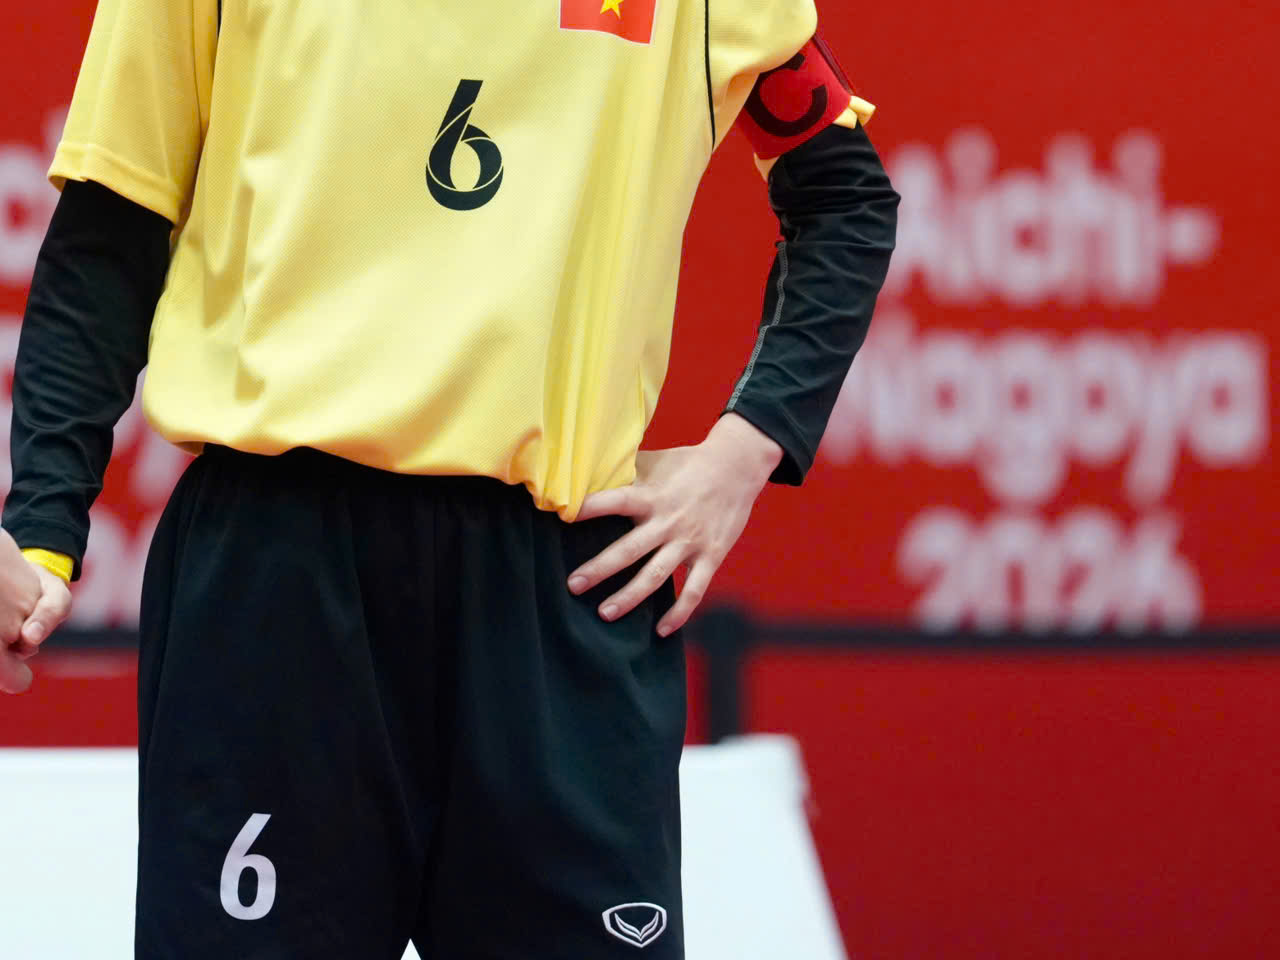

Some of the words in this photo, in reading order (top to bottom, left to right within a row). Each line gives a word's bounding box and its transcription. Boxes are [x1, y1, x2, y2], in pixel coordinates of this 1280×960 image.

[425, 78, 504, 212] 6
[743, 52, 828, 137] C
[220, 813, 277, 921] 6
